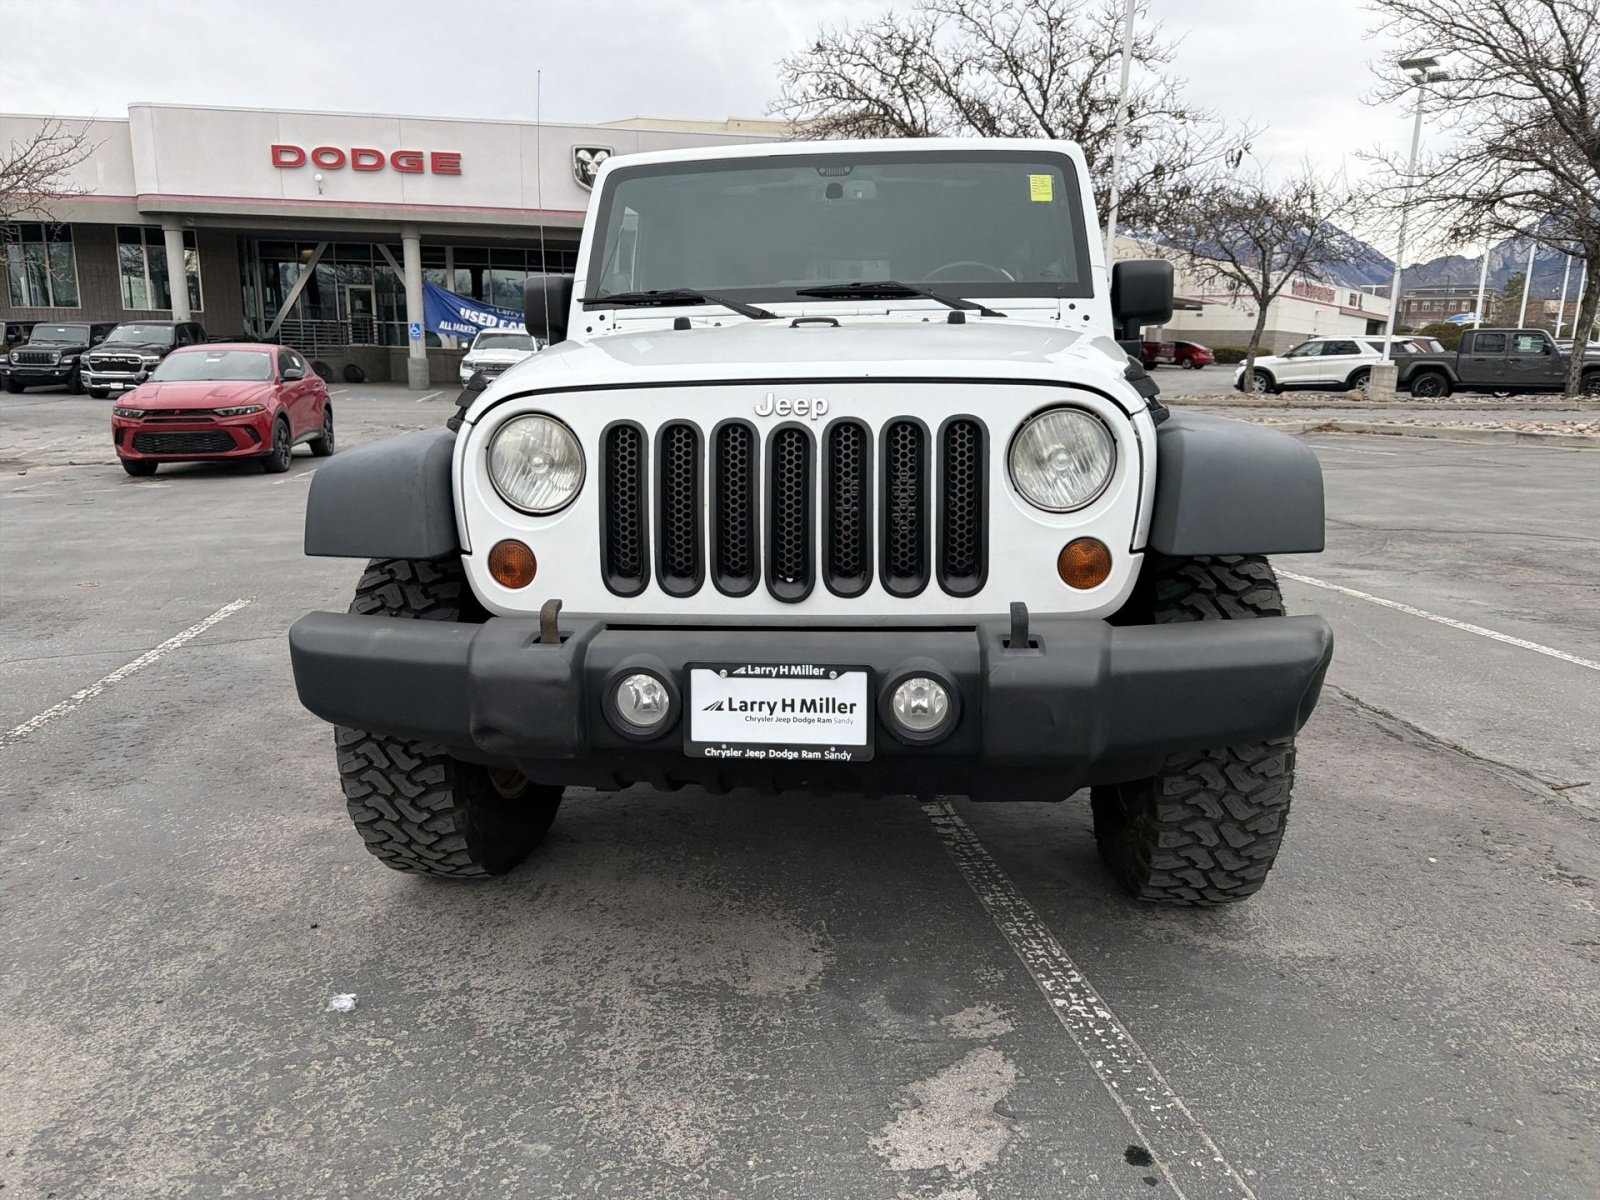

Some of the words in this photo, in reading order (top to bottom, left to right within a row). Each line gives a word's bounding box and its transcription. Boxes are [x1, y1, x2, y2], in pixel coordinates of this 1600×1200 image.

[271, 144, 462, 175] DODGE
[460, 307, 497, 327] USED
[496, 307, 521, 318] Larry
[439, 320, 452, 331] ALL
[452, 322, 477, 335] MAKES
[754, 392, 829, 420] Jeep
[747, 664, 778, 677] Larry
[779, 665, 789, 675] H
[790, 664, 825, 676] Miller
[728, 697, 778, 716] Larry
[781, 698, 795, 713] H
[799, 697, 857, 714] Miller
[744, 715, 774, 724] Chrysler
[775, 716, 792, 724] Jeep
[792, 717, 816, 725] Dodge
[833, 717, 854, 725] Sandy
[704, 748, 743, 759] Chrysler
[744, 749, 766, 760] Jeep
[768, 749, 799, 760] Dodge
[801, 750, 822, 760] Ram
[824, 751, 852, 762] Sandy
